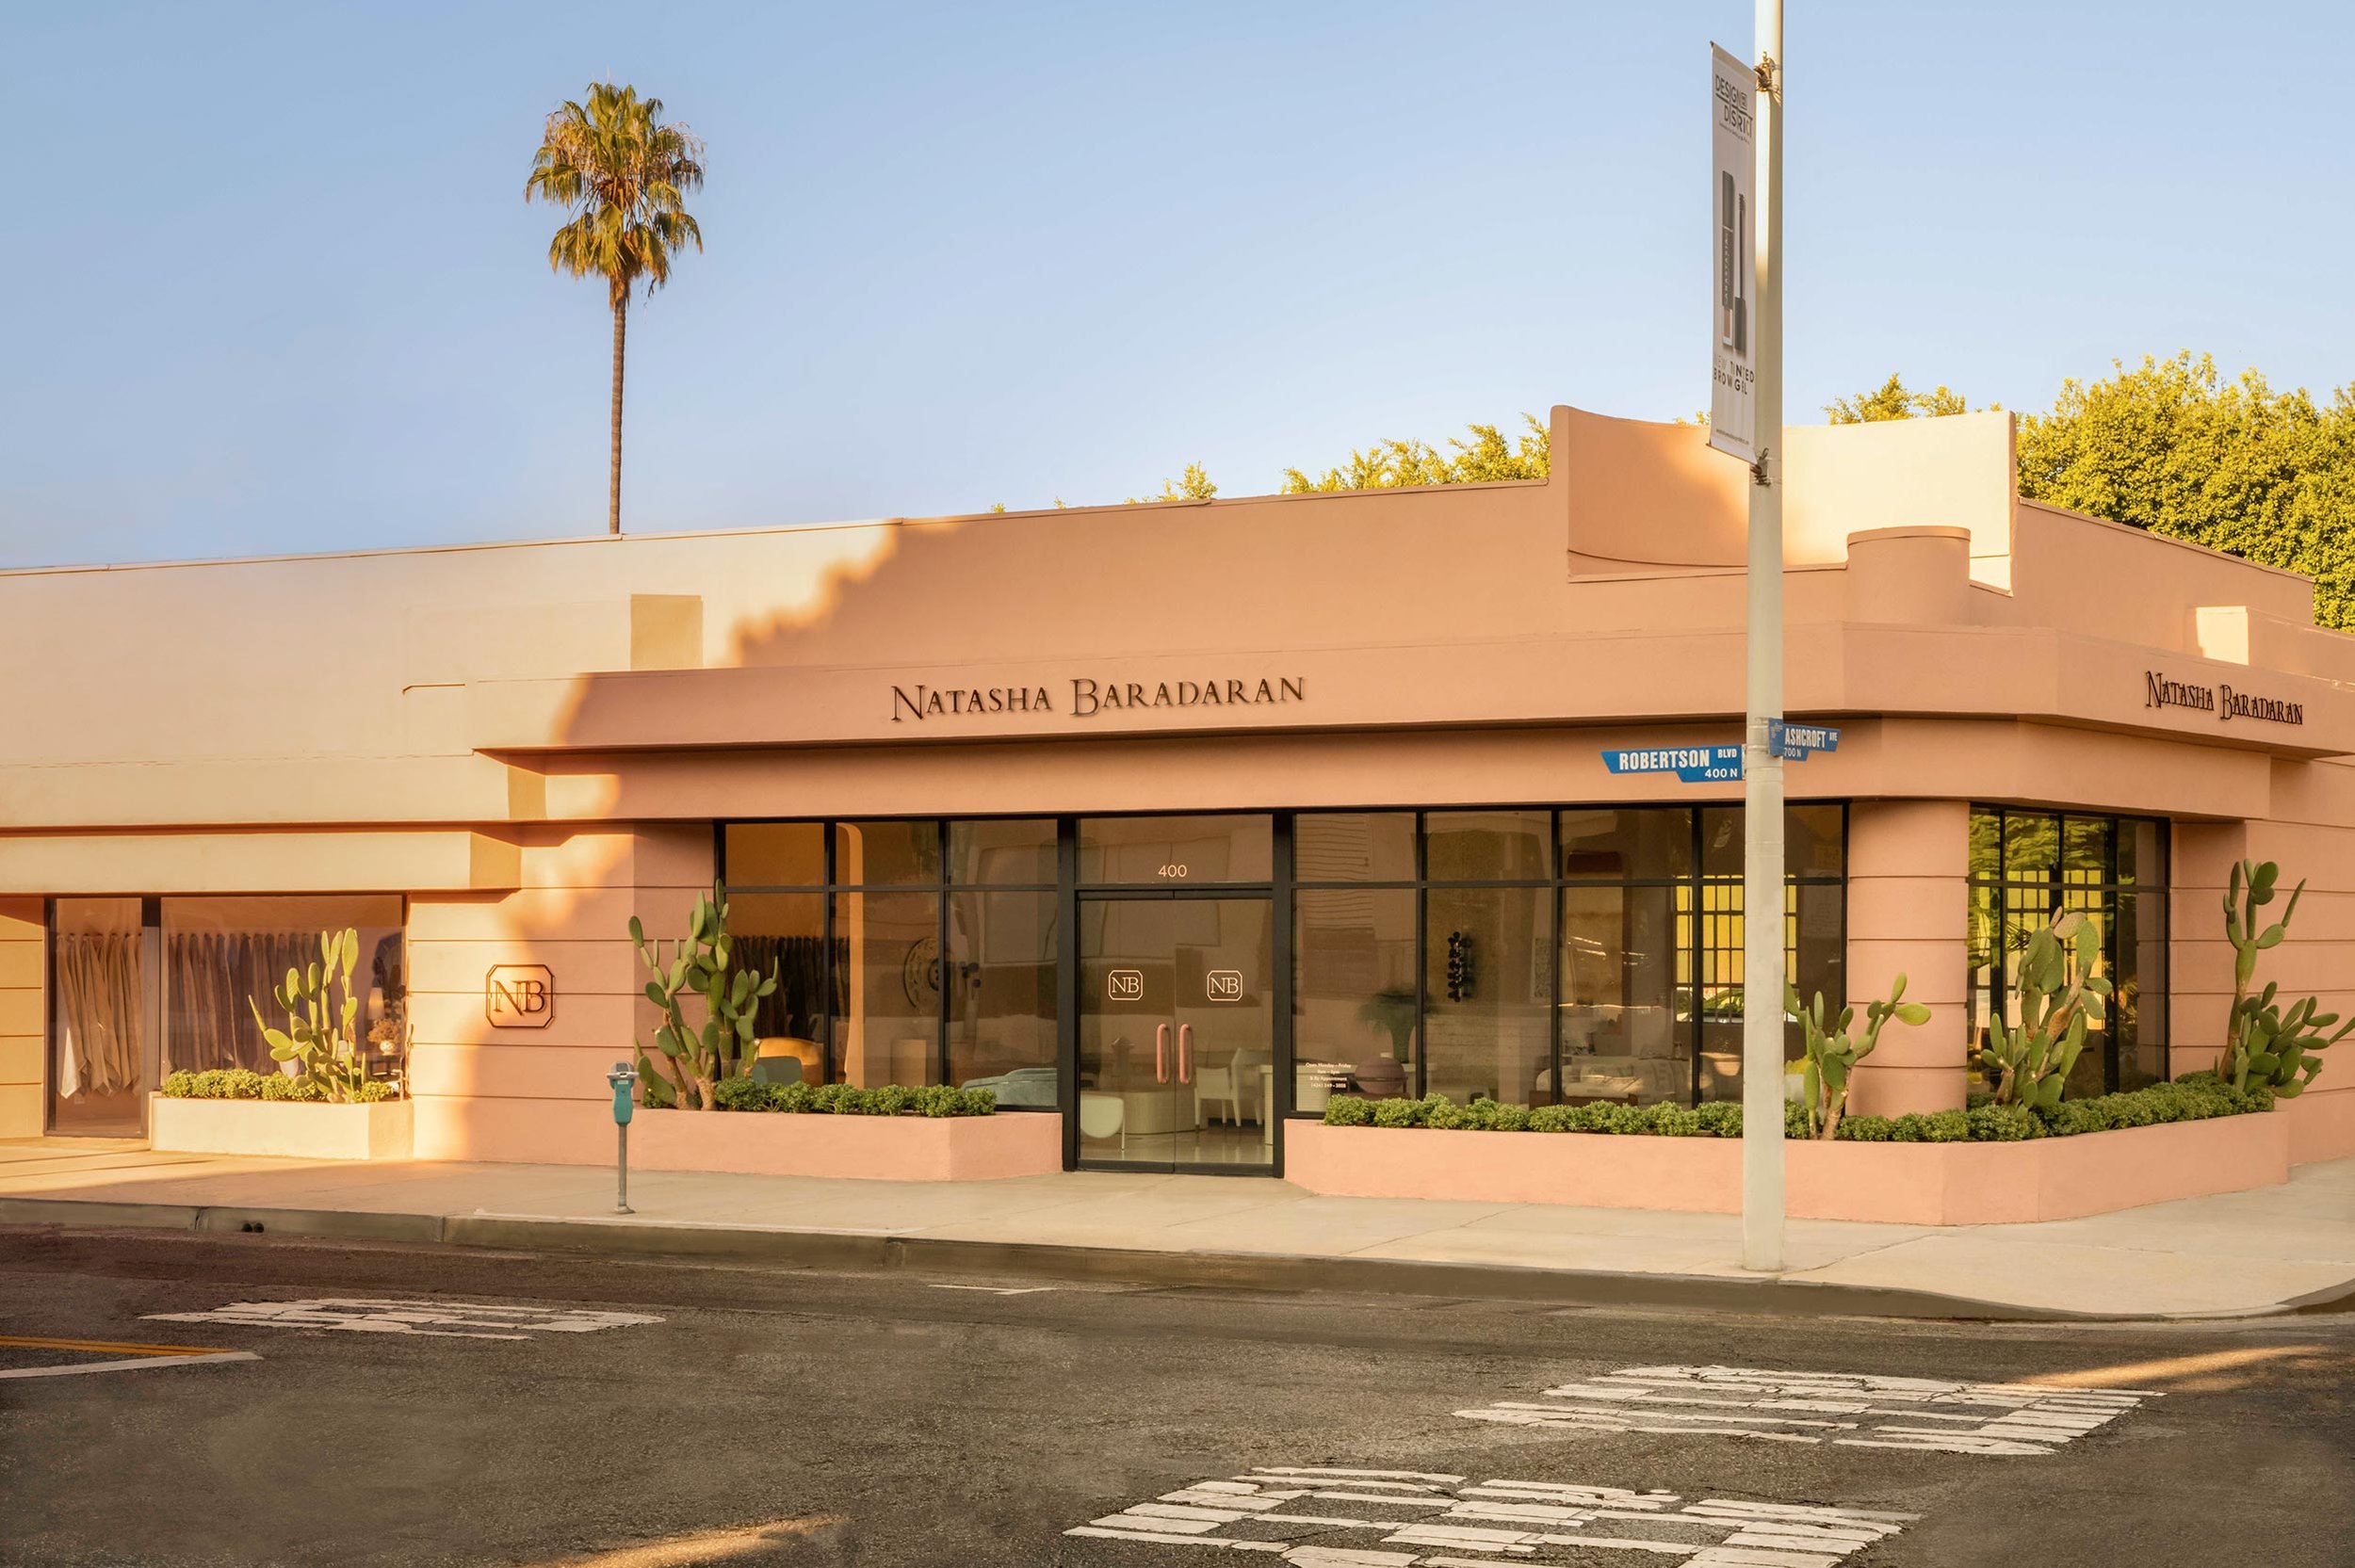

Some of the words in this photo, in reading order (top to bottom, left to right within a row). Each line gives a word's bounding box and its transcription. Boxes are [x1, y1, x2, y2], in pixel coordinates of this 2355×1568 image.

[890, 684, 1053, 722] NATASHA
[1070, 676, 1306, 717] BARADARAN
[2145, 671, 2215, 712] NATASHA
[2219, 684, 2303, 725] BARADARAN
[1784, 727, 1827, 749] ASHCROFT
[1828, 732, 1838, 742] AVE
[1618, 749, 1711, 770] ROBERTSON
[1717, 748, 1738, 759] BLVD
[1796, 748, 1802, 758] N
[1704, 768, 1729, 779] 400
[1730, 768, 1738, 778] N
[1158, 865, 1188, 878] 400
[1112, 977, 1140, 994] NB
[1210, 977, 1240, 994] NB
[493, 979, 545, 1016] NB
